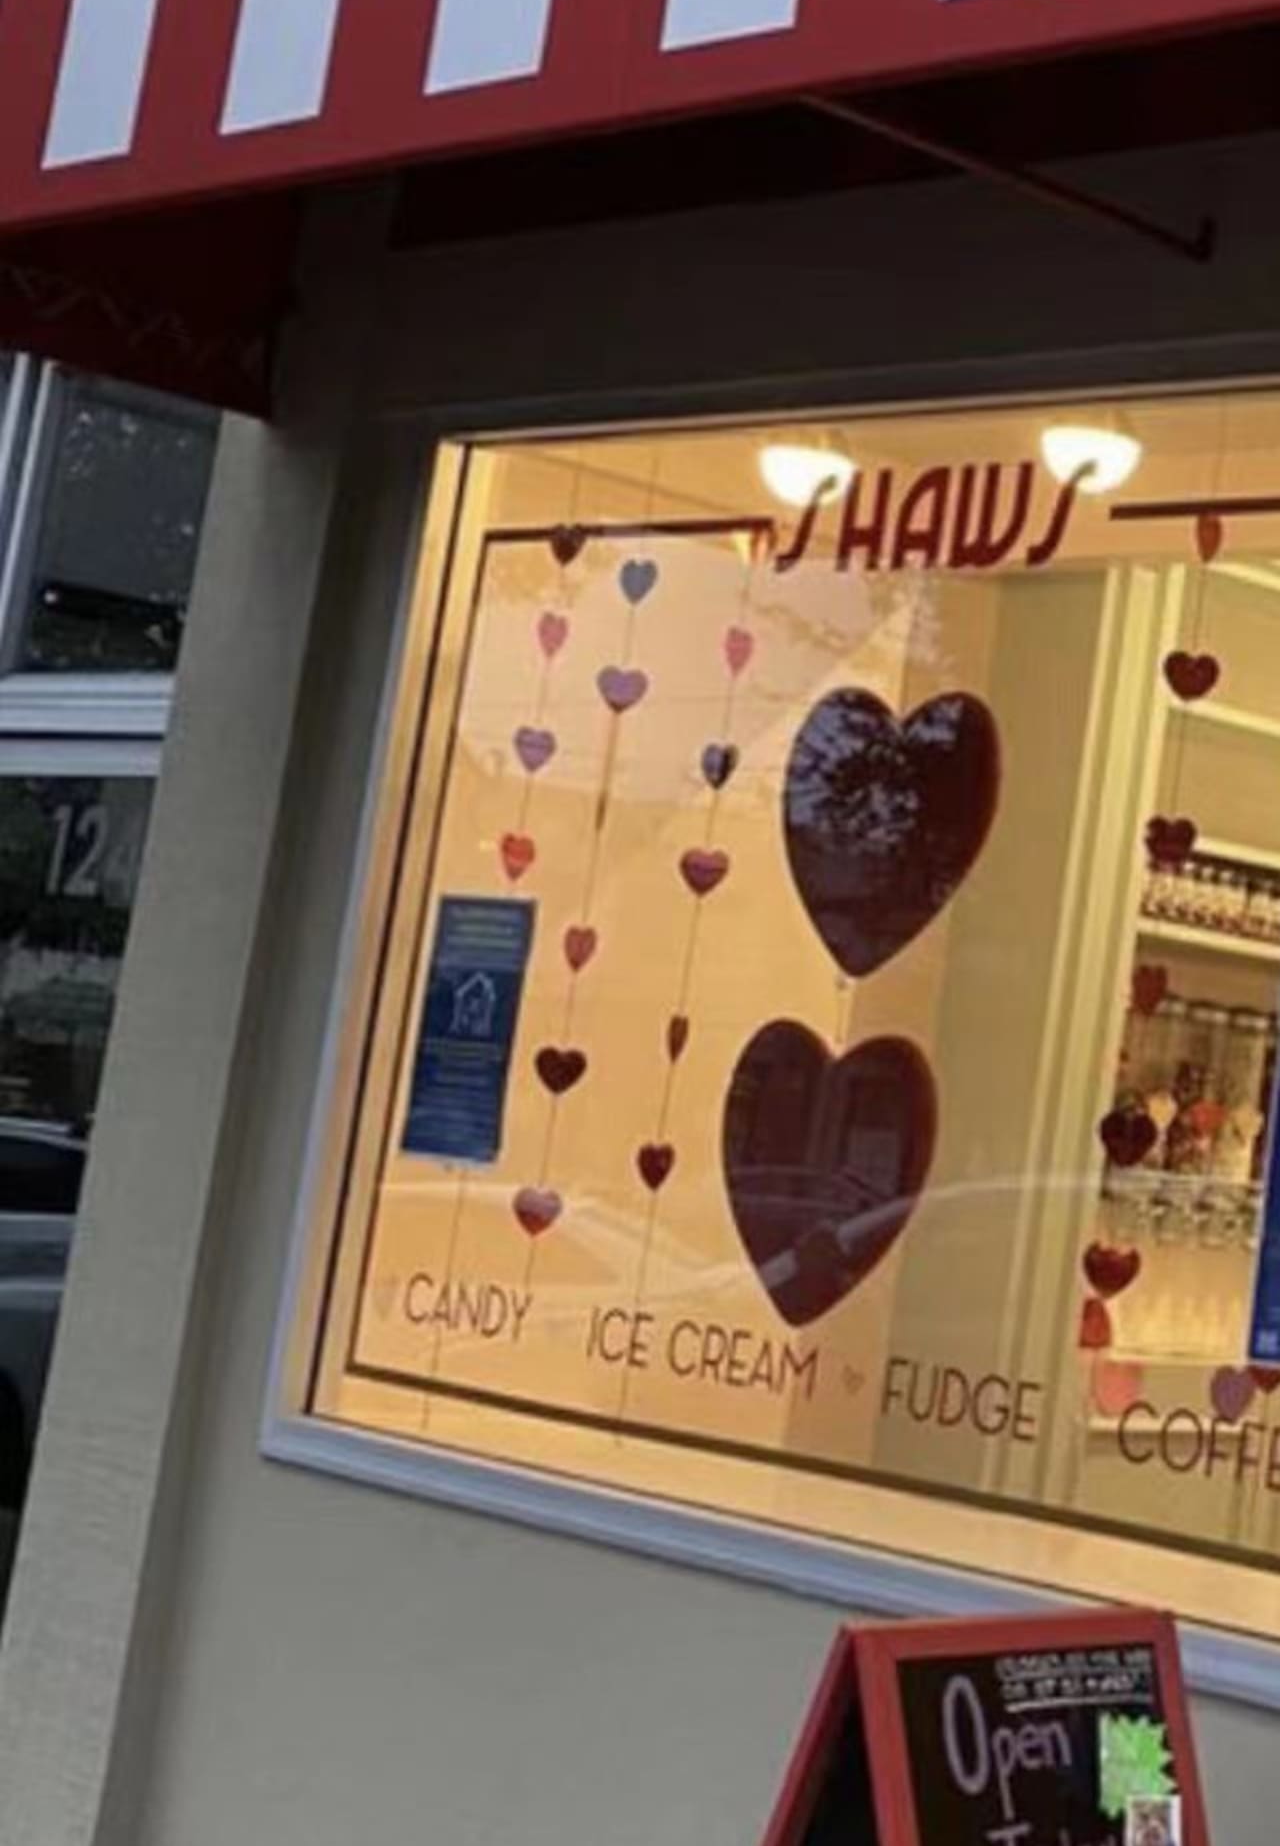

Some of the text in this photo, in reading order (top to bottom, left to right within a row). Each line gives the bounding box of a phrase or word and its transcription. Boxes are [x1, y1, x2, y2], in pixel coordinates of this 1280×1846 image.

[774, 458, 1098, 573] SHAWS
[403, 1272, 534, 1344] CANDY
[585, 1305, 655, 1370] ICE
[668, 1319, 820, 1401] CREAM
[880, 1357, 1043, 1442] FUDGE
[942, 1674, 1073, 1822] Open
